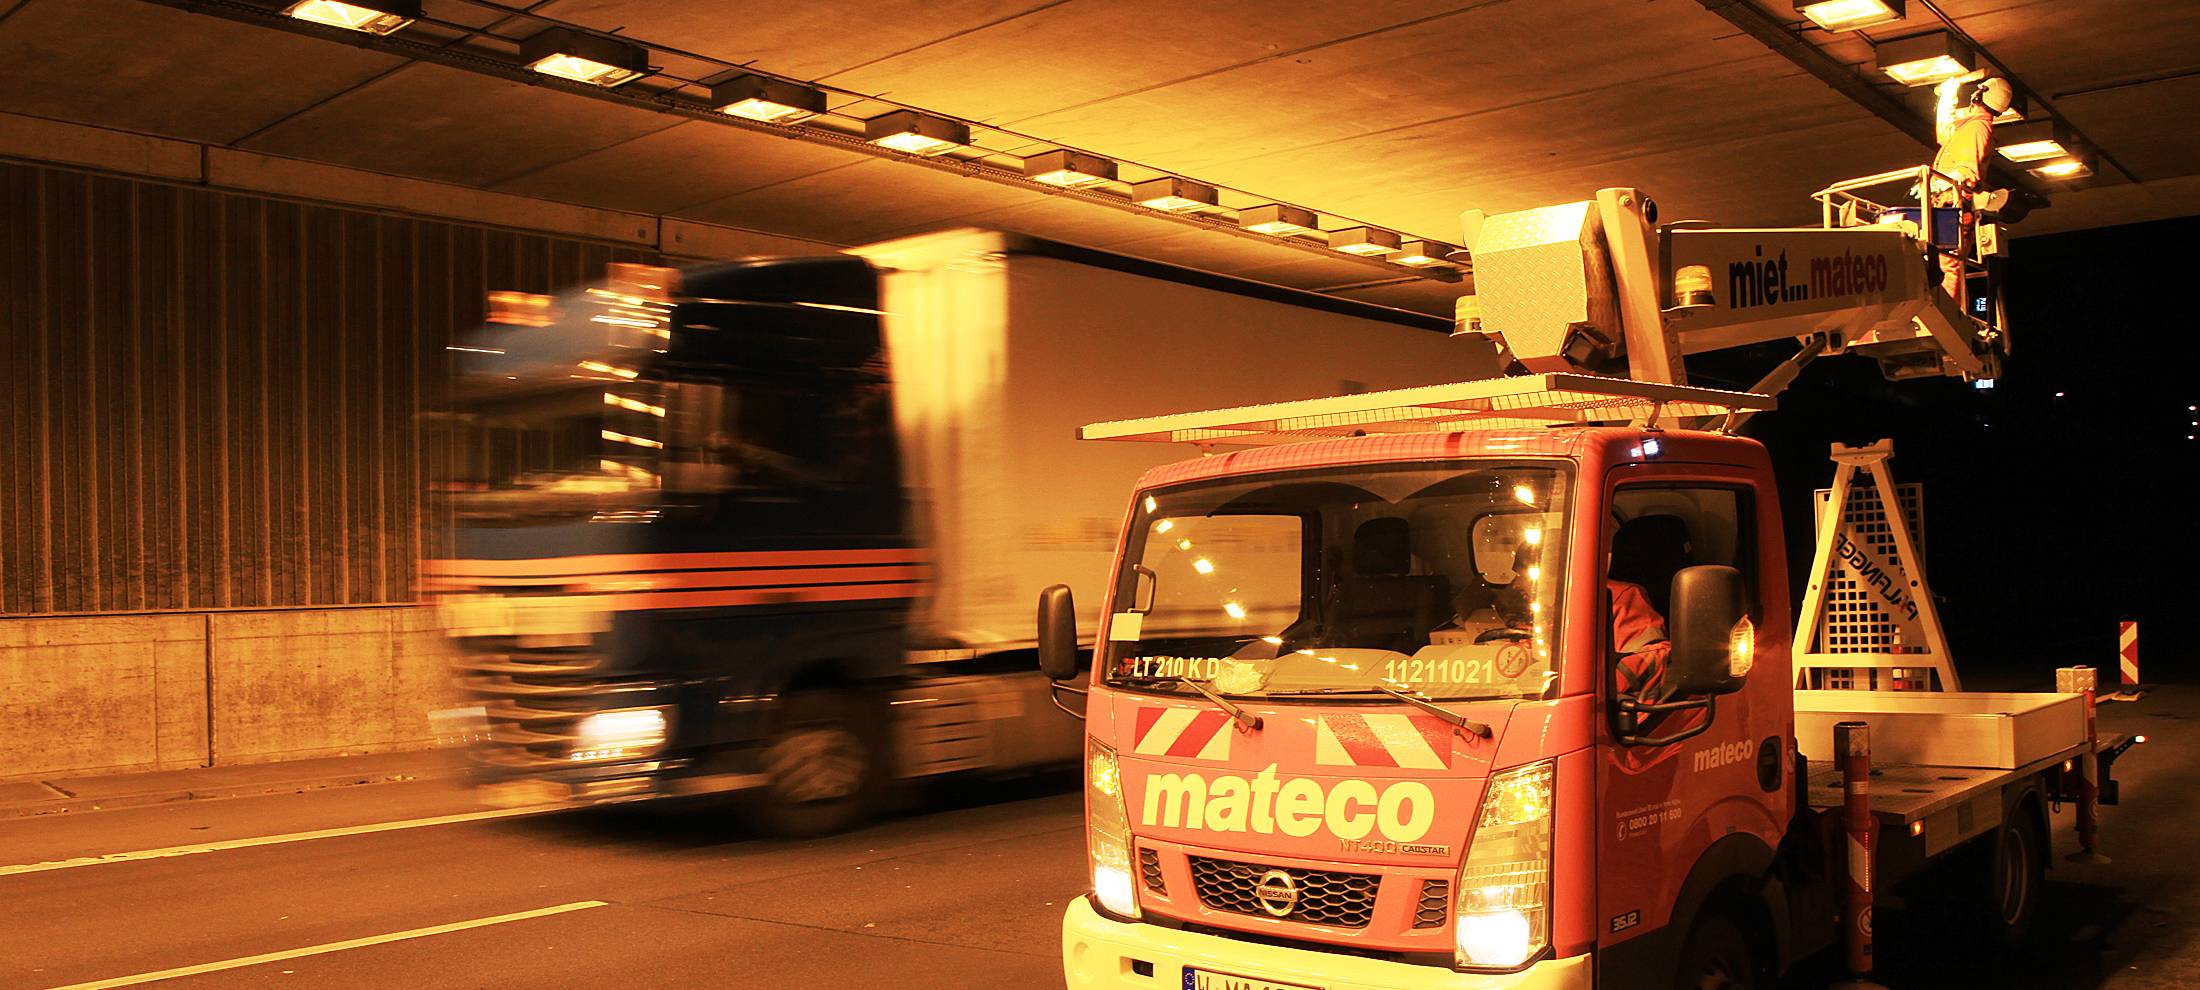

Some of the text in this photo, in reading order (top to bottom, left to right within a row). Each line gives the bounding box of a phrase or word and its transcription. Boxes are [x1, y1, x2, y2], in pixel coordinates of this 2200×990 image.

[1811, 247, 1888, 299] mateco
[1133, 656, 1153, 677] LT
[1154, 656, 1185, 677] 210
[1188, 657, 1203, 679] K
[1385, 659, 1492, 684] 11211021
[1693, 739, 1753, 773] mateco
[1142, 763, 1434, 842] mateco
